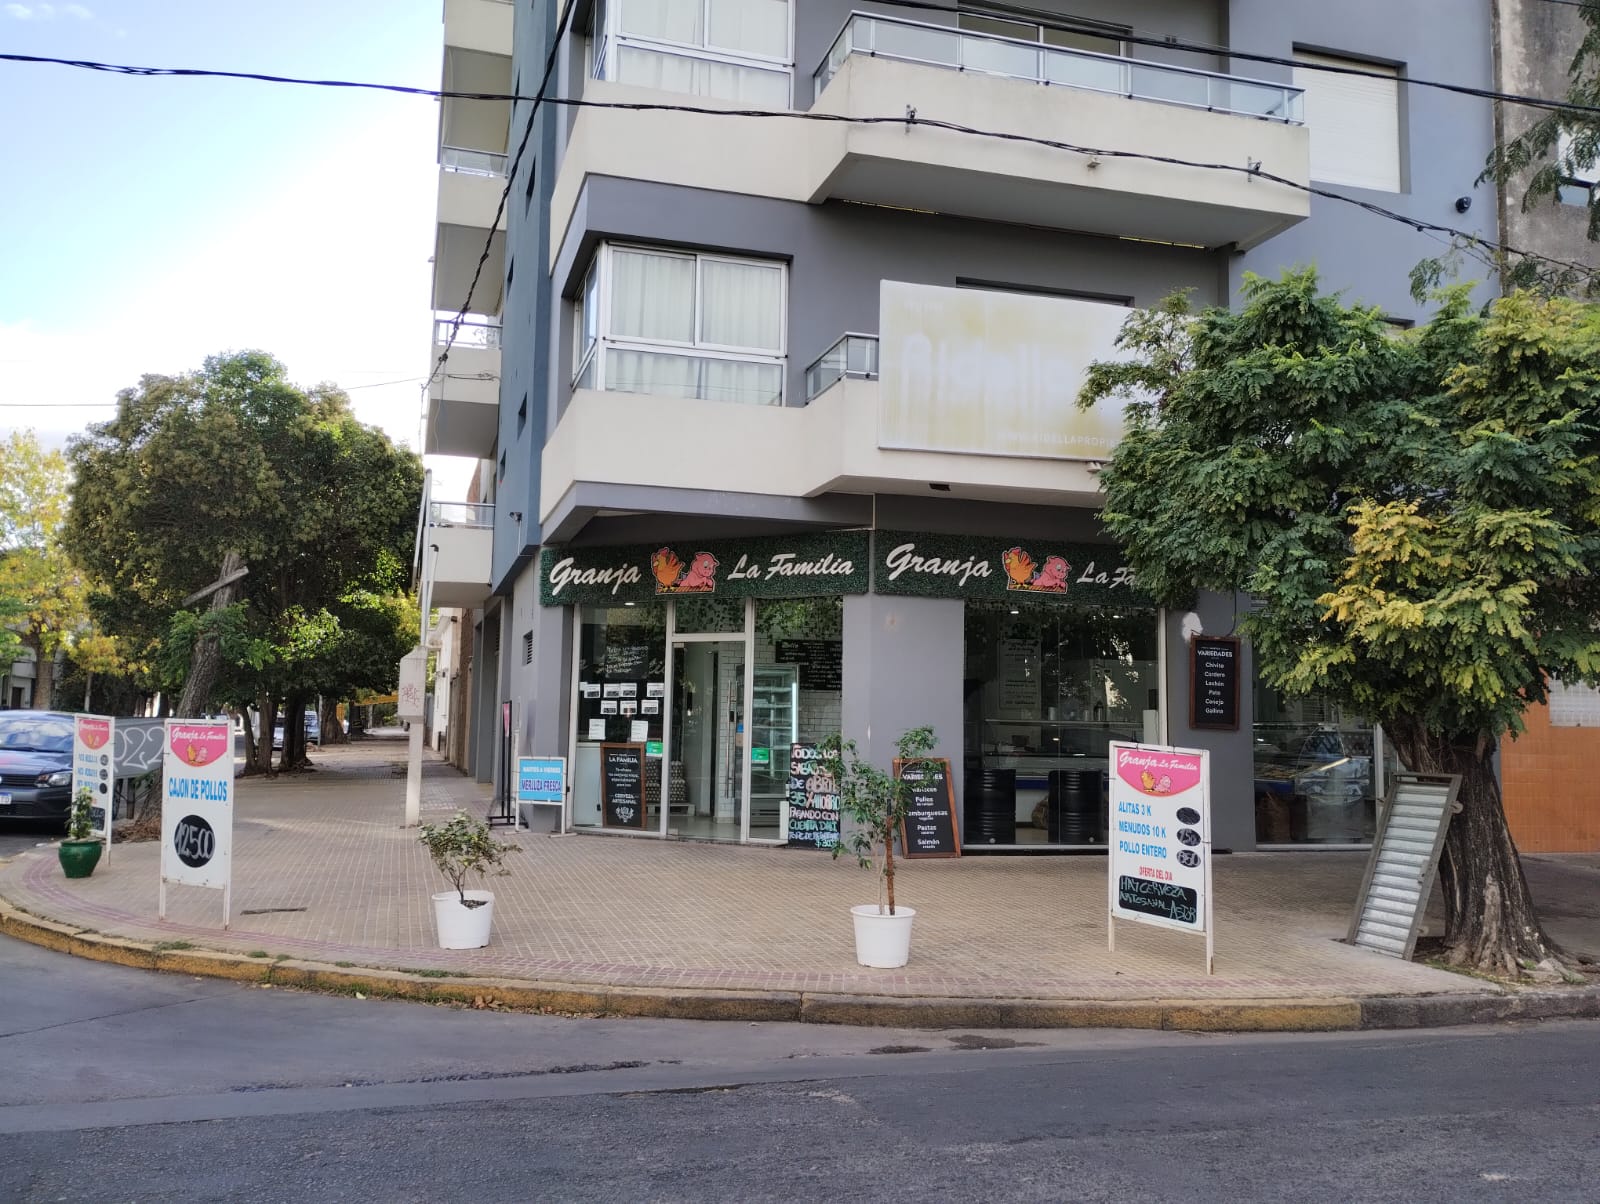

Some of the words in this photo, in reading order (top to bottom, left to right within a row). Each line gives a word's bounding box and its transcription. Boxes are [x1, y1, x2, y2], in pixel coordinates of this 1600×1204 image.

[550, 557, 642, 595] Granja
[727, 554, 761, 580] La
[764, 553, 854, 580] Familia
[886, 544, 992, 586] Granja
[1077, 561, 1110, 584] La
[1197, 650, 1233, 658] VARIEDADES
[172, 727, 199, 743] Granja
[1120, 751, 1157, 770] Granja
[1169, 760, 1198, 771] Familia
[168, 777, 189, 798] CAJON
[191, 779, 199, 800] DE
[200, 780, 228, 801] POLLOS
[1119, 801, 1139, 815] ALITAS
[1147, 805, 1152, 816] K
[1119, 820, 1150, 836] MENUDOS
[1152, 826, 1159, 837] 10
[1161, 827, 1167, 838] K
[175, 822, 215, 859] 12500
[1120, 841, 1140, 854] POLLO
[1142, 844, 1167, 859] ENTERO
[1139, 866, 1155, 878] OFERTA
[1155, 870, 1164, 880] DEL
[1165, 871, 1173, 881] DIA
[1120, 877, 1140, 893] HAY
[1140, 882, 1187, 901] CERVEZA
